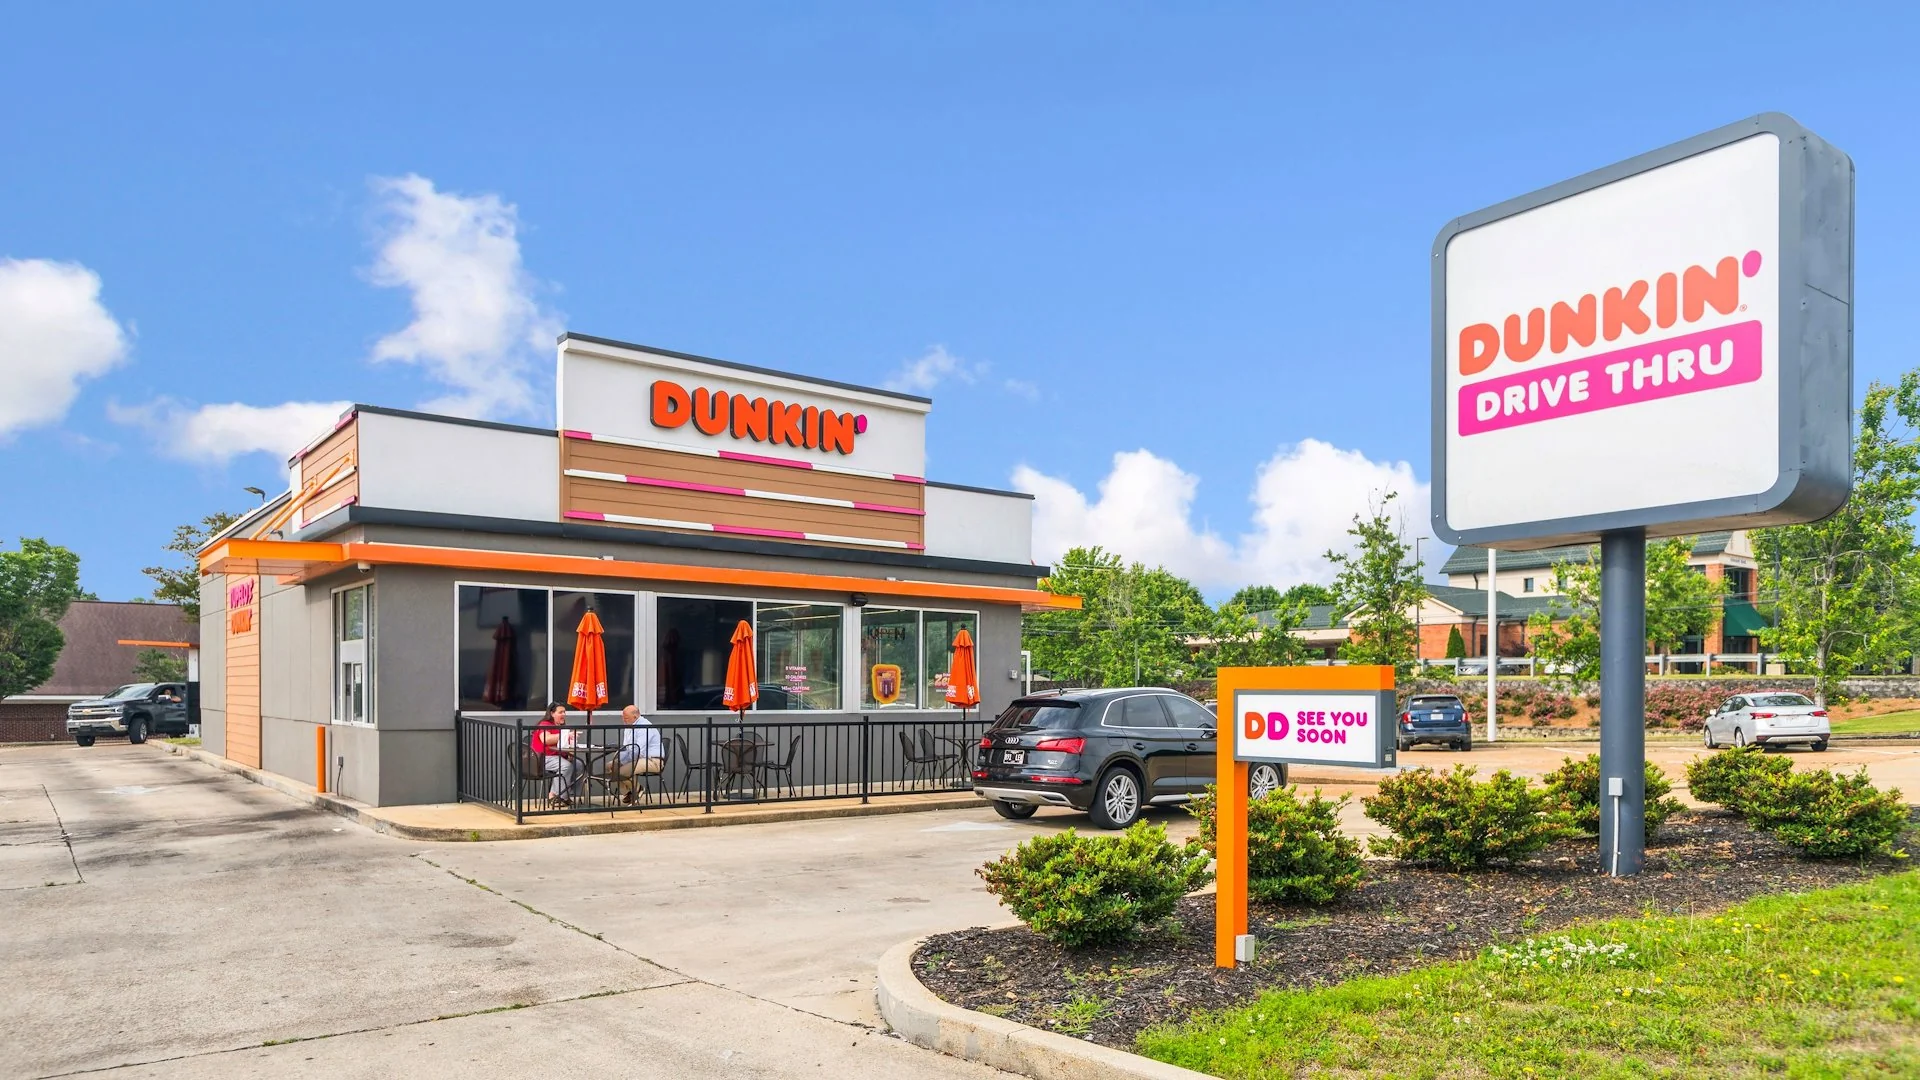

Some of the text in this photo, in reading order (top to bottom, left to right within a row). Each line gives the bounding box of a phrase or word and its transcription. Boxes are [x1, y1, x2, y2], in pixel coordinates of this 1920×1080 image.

[1458, 250, 1762, 376] DUNKIN'
[1476, 339, 1734, 422] DRIVE THRU
[650, 380, 868, 455] DUNKIN'
[1244, 711, 1289, 740] DD
[1297, 711, 1368, 727] SEE YOU
[1297, 729, 1346, 744] SOON
